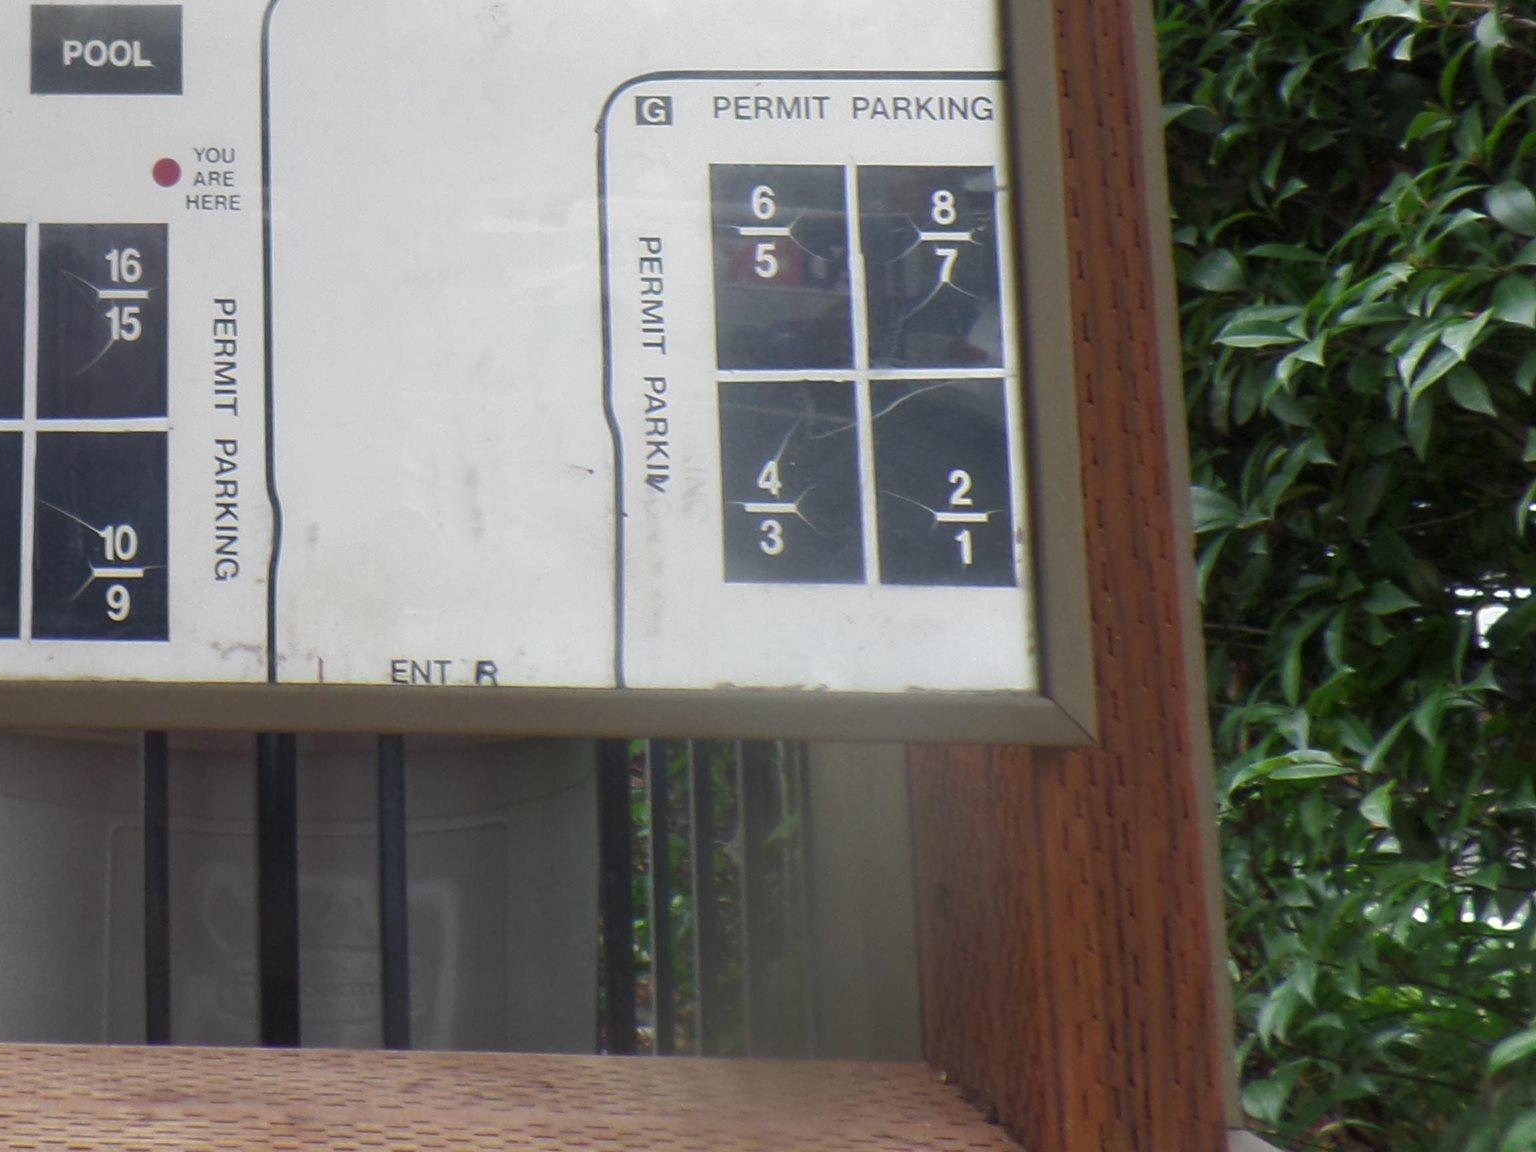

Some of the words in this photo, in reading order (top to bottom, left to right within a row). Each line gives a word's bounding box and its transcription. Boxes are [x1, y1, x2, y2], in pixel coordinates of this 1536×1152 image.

[62, 39, 152, 67] POOL
[640, 98, 668, 124] G
[712, 95, 830, 122] PERMIT
[851, 96, 995, 124] PARKING
[192, 147, 236, 165] YOU
[192, 170, 235, 188] ARE
[185, 194, 241, 212] HERE
[751, 186, 776, 220] 6
[931, 190, 956, 225] 8
[105, 248, 142, 284] 16
[755, 244, 779, 278] 5
[935, 248, 958, 283] 7
[639, 237, 666, 355] PERMIT
[106, 307, 142, 344] 15
[212, 297, 237, 418] PERMIT
[758, 460, 780, 495] 4
[948, 471, 973, 505] 2
[212, 439, 239, 584] PARKING
[101, 526, 138, 560] 10
[759, 520, 784, 555] 3
[955, 530, 972, 565] 1
[106, 586, 130, 621] 9
